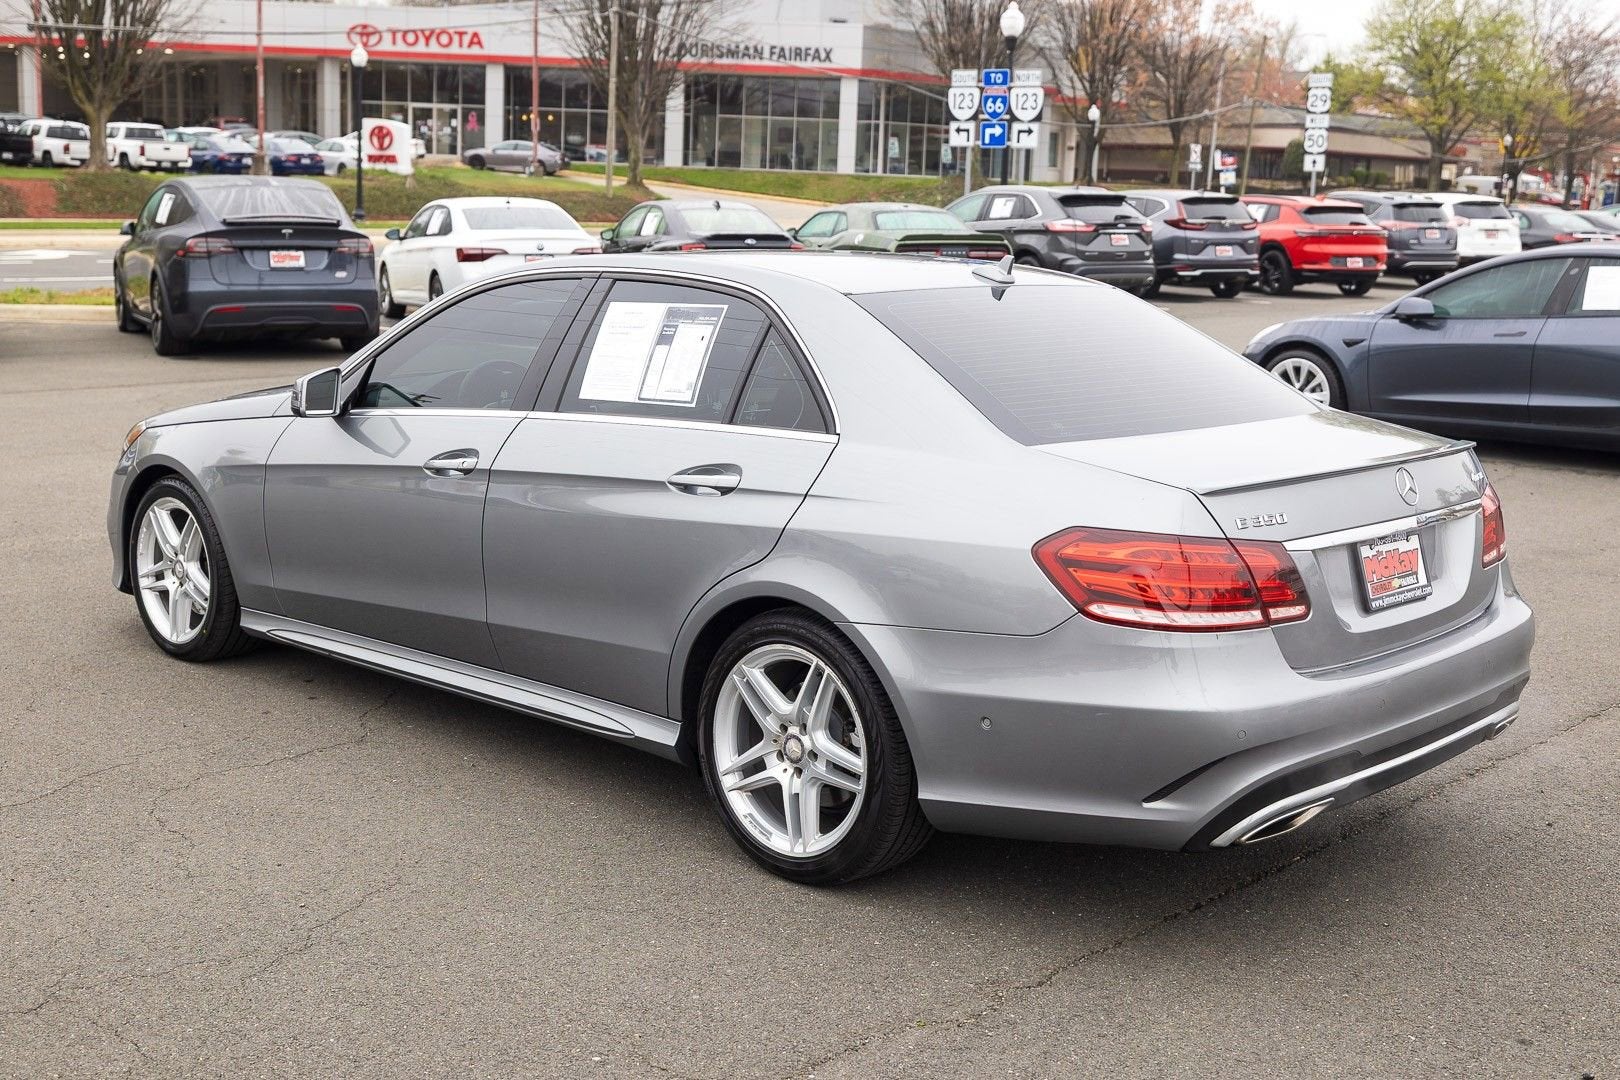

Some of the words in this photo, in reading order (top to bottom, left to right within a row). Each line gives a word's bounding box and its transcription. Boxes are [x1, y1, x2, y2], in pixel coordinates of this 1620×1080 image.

[388, 29, 484, 49] TOYOTA
[769, 45, 832, 62] FAIRFAX
[952, 73, 977, 82] SOUTH
[989, 73, 1003, 84] TO
[1015, 73, 1040, 82] NORTH
[953, 93, 975, 110] 123
[986, 97, 1004, 113] 66
[1015, 93, 1038, 110] 123
[1311, 94, 1328, 108] 29
[1307, 134, 1324, 148] 50
[1235, 518, 1248, 530] E
[1251, 512, 1287, 527] 350
[1363, 547, 1418, 583] McKay
